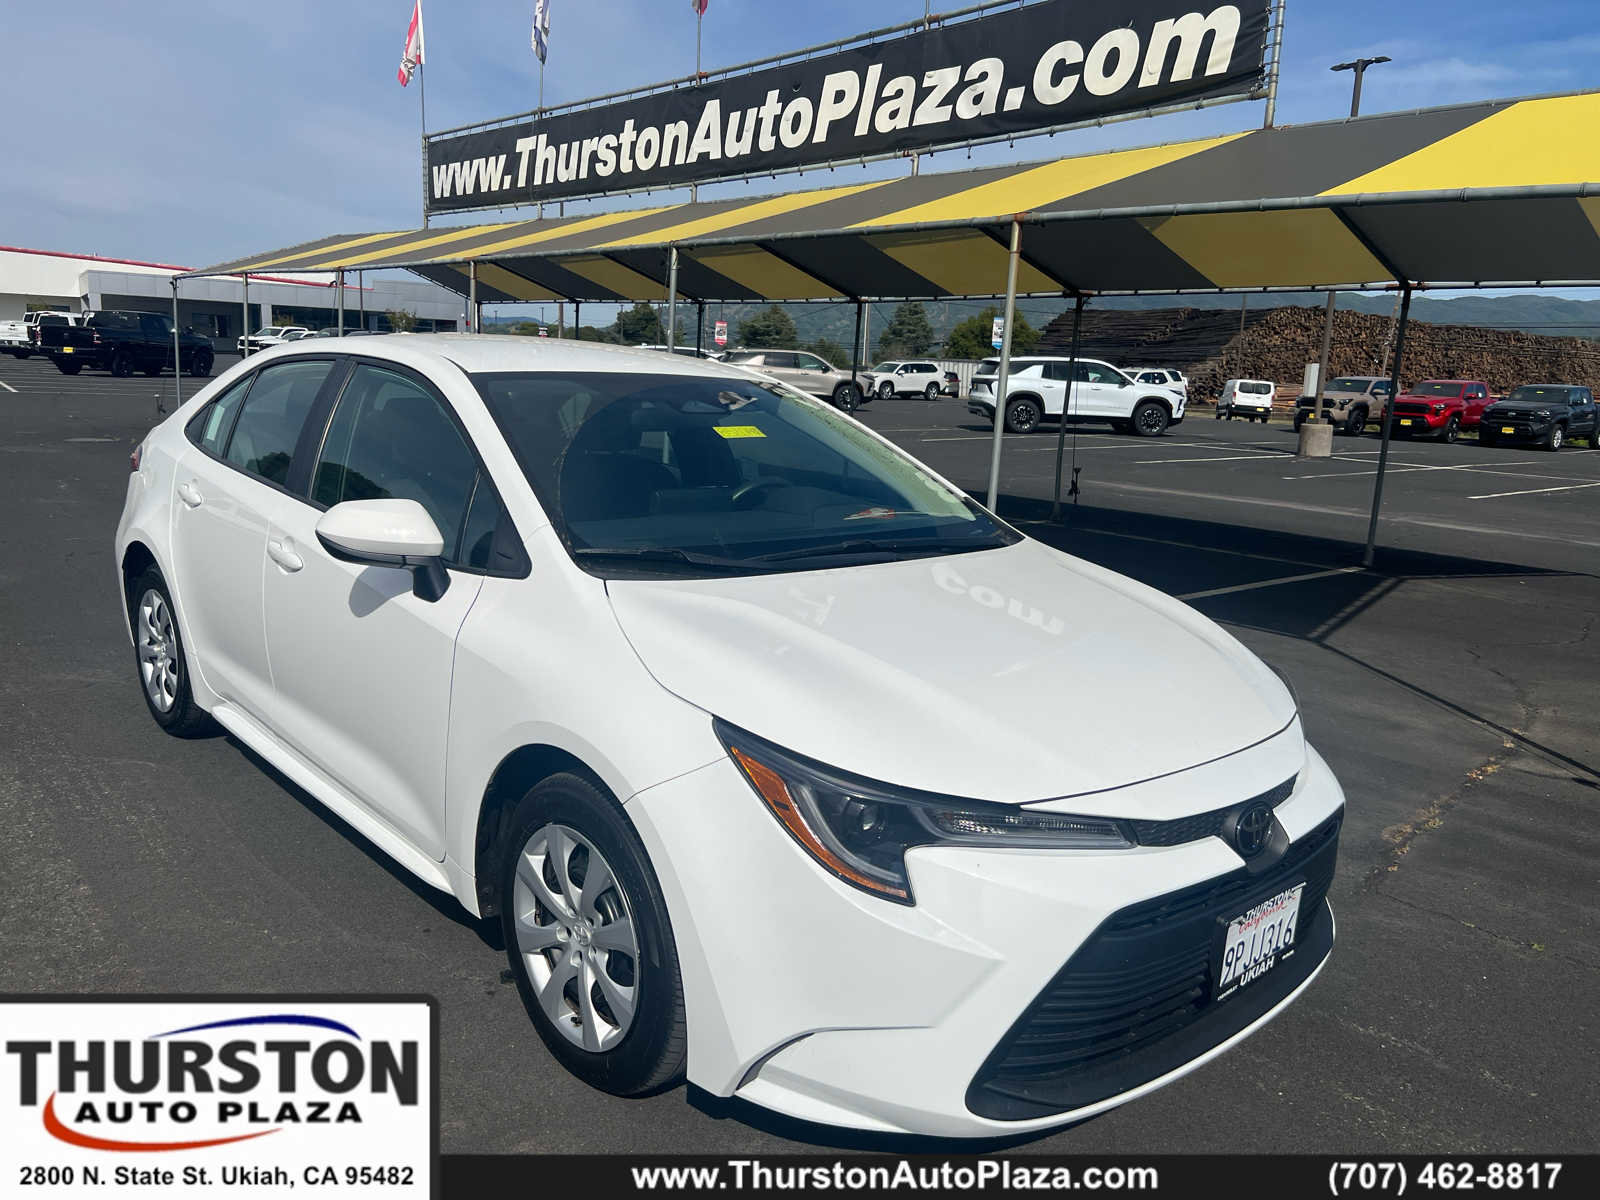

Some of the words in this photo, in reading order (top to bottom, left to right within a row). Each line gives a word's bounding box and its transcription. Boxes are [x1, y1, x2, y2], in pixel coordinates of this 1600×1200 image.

[432, 5, 1242, 199] www.ThurstonAutoPlaza.com
[1223, 910, 1297, 985] 9PJJ316
[1240, 955, 1275, 987] UKIAH
